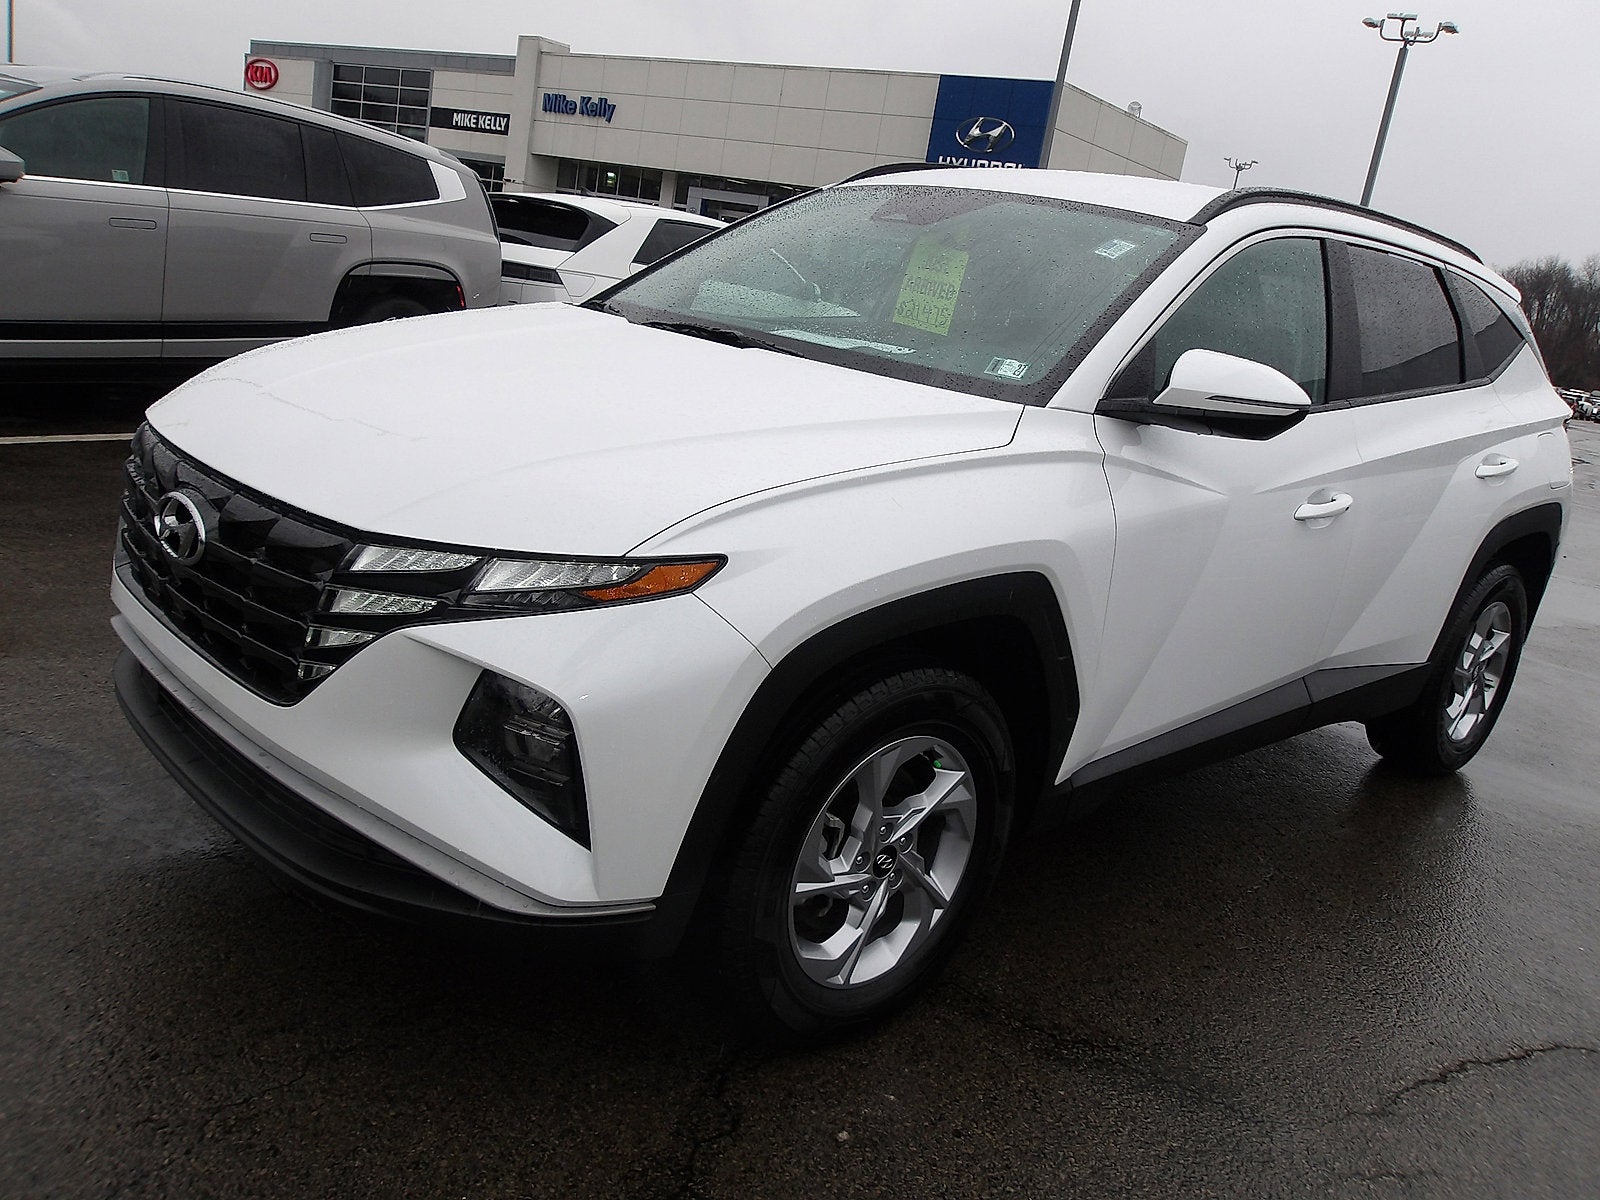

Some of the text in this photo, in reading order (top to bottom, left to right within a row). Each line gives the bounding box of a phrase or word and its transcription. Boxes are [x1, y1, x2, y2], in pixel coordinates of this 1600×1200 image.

[249, 65, 272, 83] KIA
[542, 92, 617, 123] Mike Kelly
[452, 112, 508, 131] MIKE KELLY
